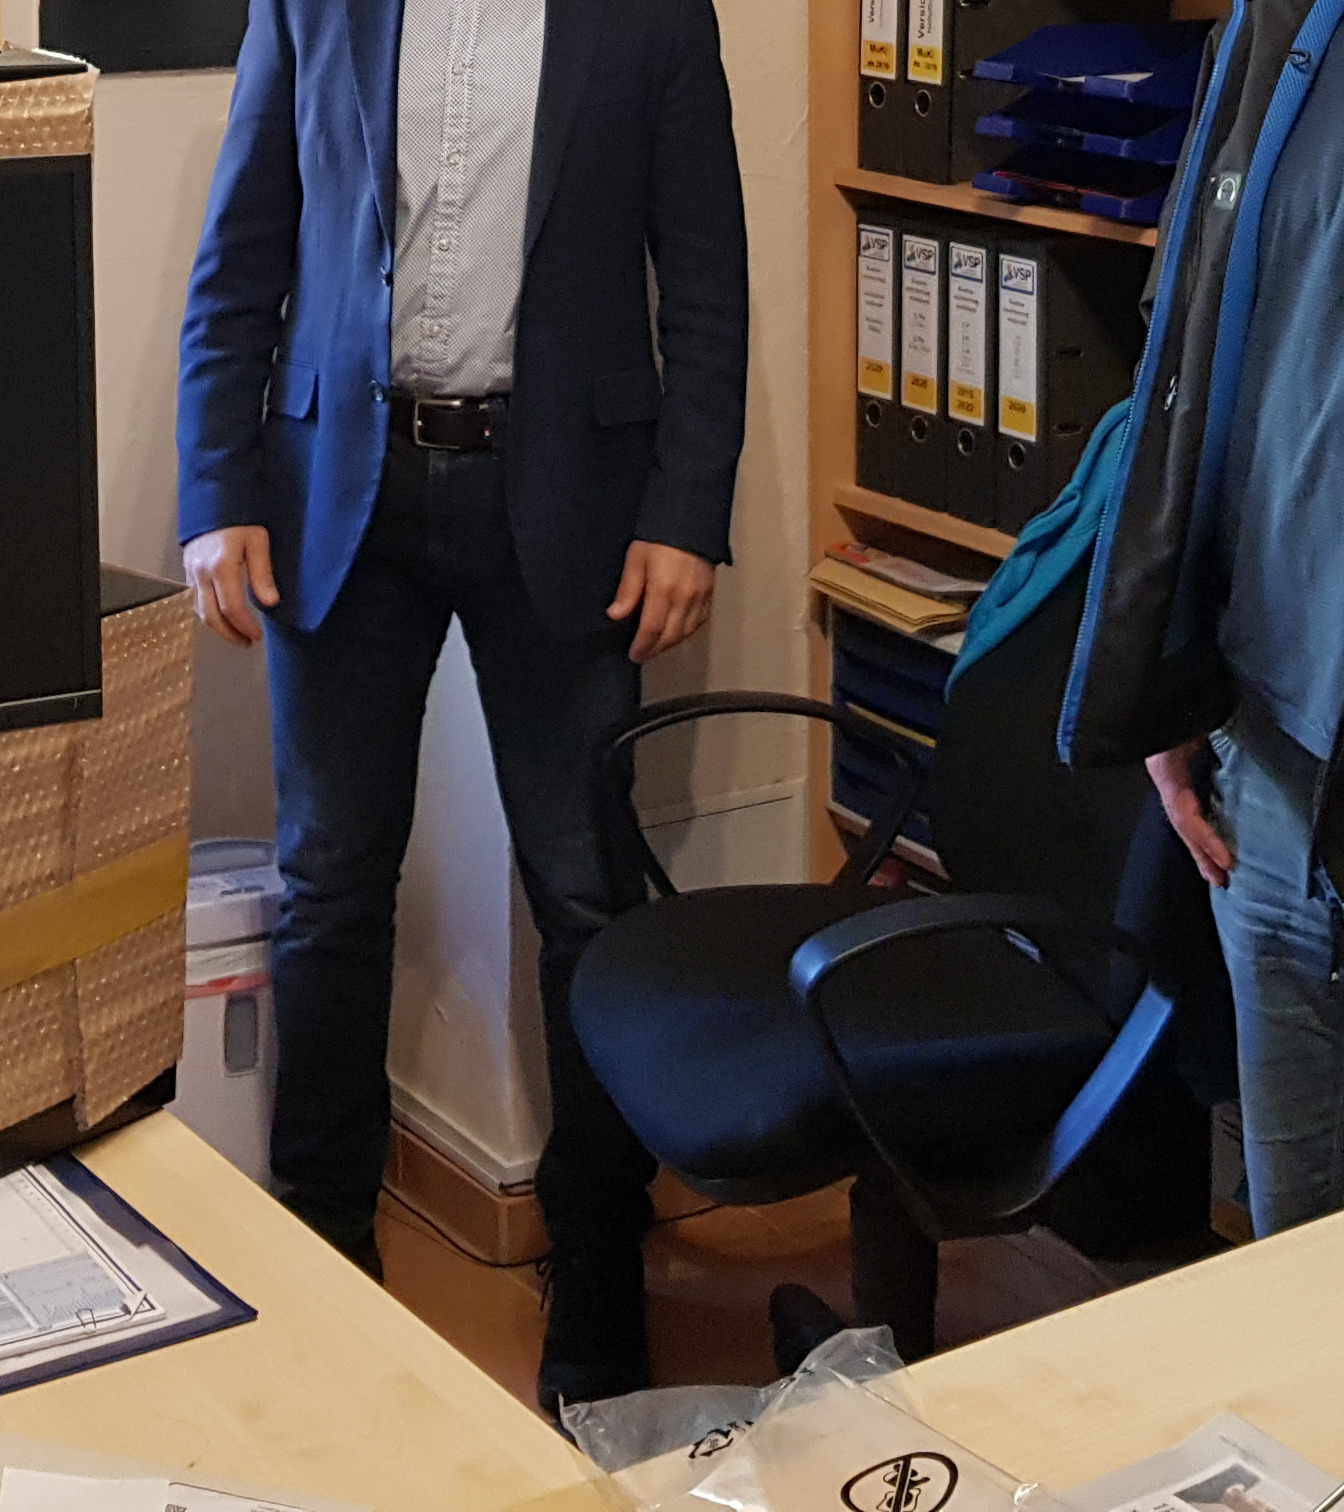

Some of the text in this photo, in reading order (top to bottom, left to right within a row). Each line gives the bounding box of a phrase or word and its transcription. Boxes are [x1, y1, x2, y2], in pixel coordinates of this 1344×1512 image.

[870, 238, 888, 250] VSP
[916, 248, 935, 260] VSP
[962, 254, 981, 267] VSP
[1013, 267, 1032, 282] VSP
